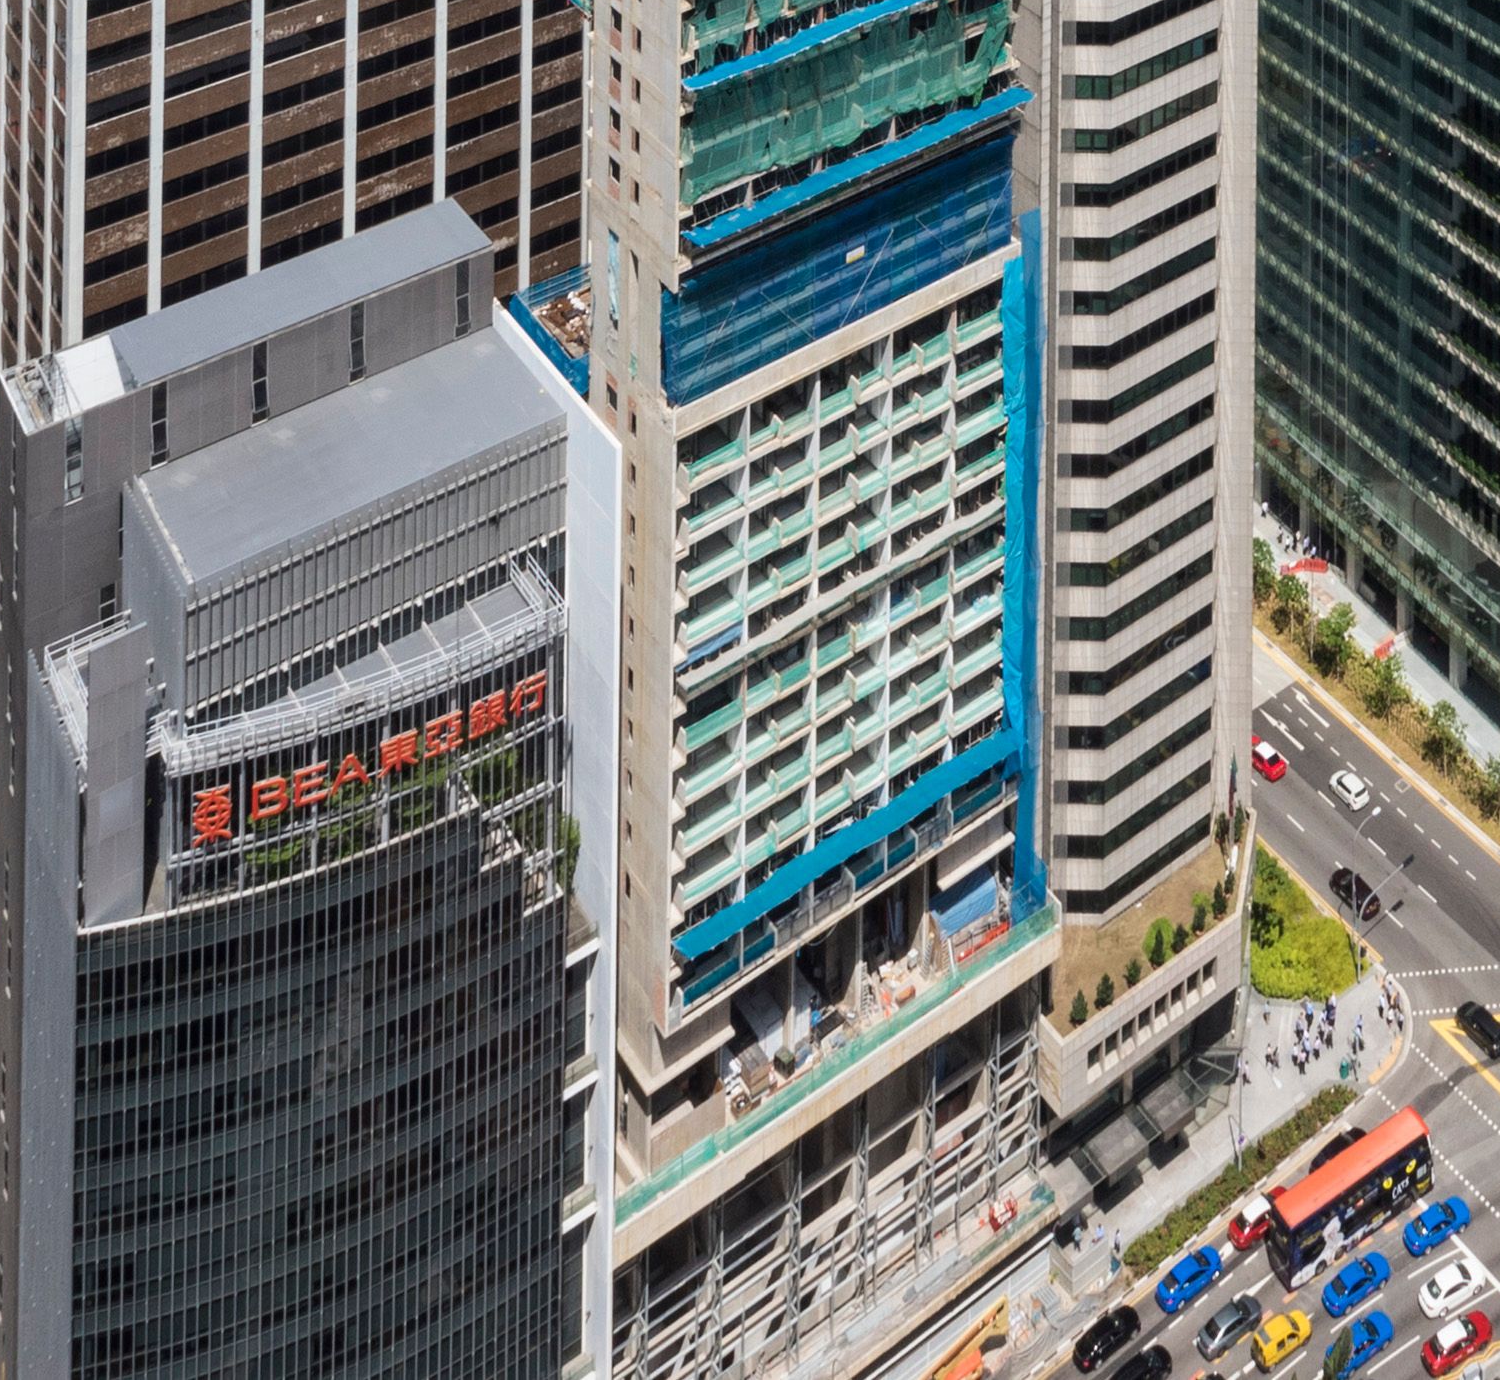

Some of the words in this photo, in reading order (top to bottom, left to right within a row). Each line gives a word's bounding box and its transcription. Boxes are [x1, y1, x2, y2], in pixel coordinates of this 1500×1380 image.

[250, 752, 370, 822] BEA
[378, 669, 548, 779] 東亞銀行
[1392, 1177, 1410, 1200] CATS
